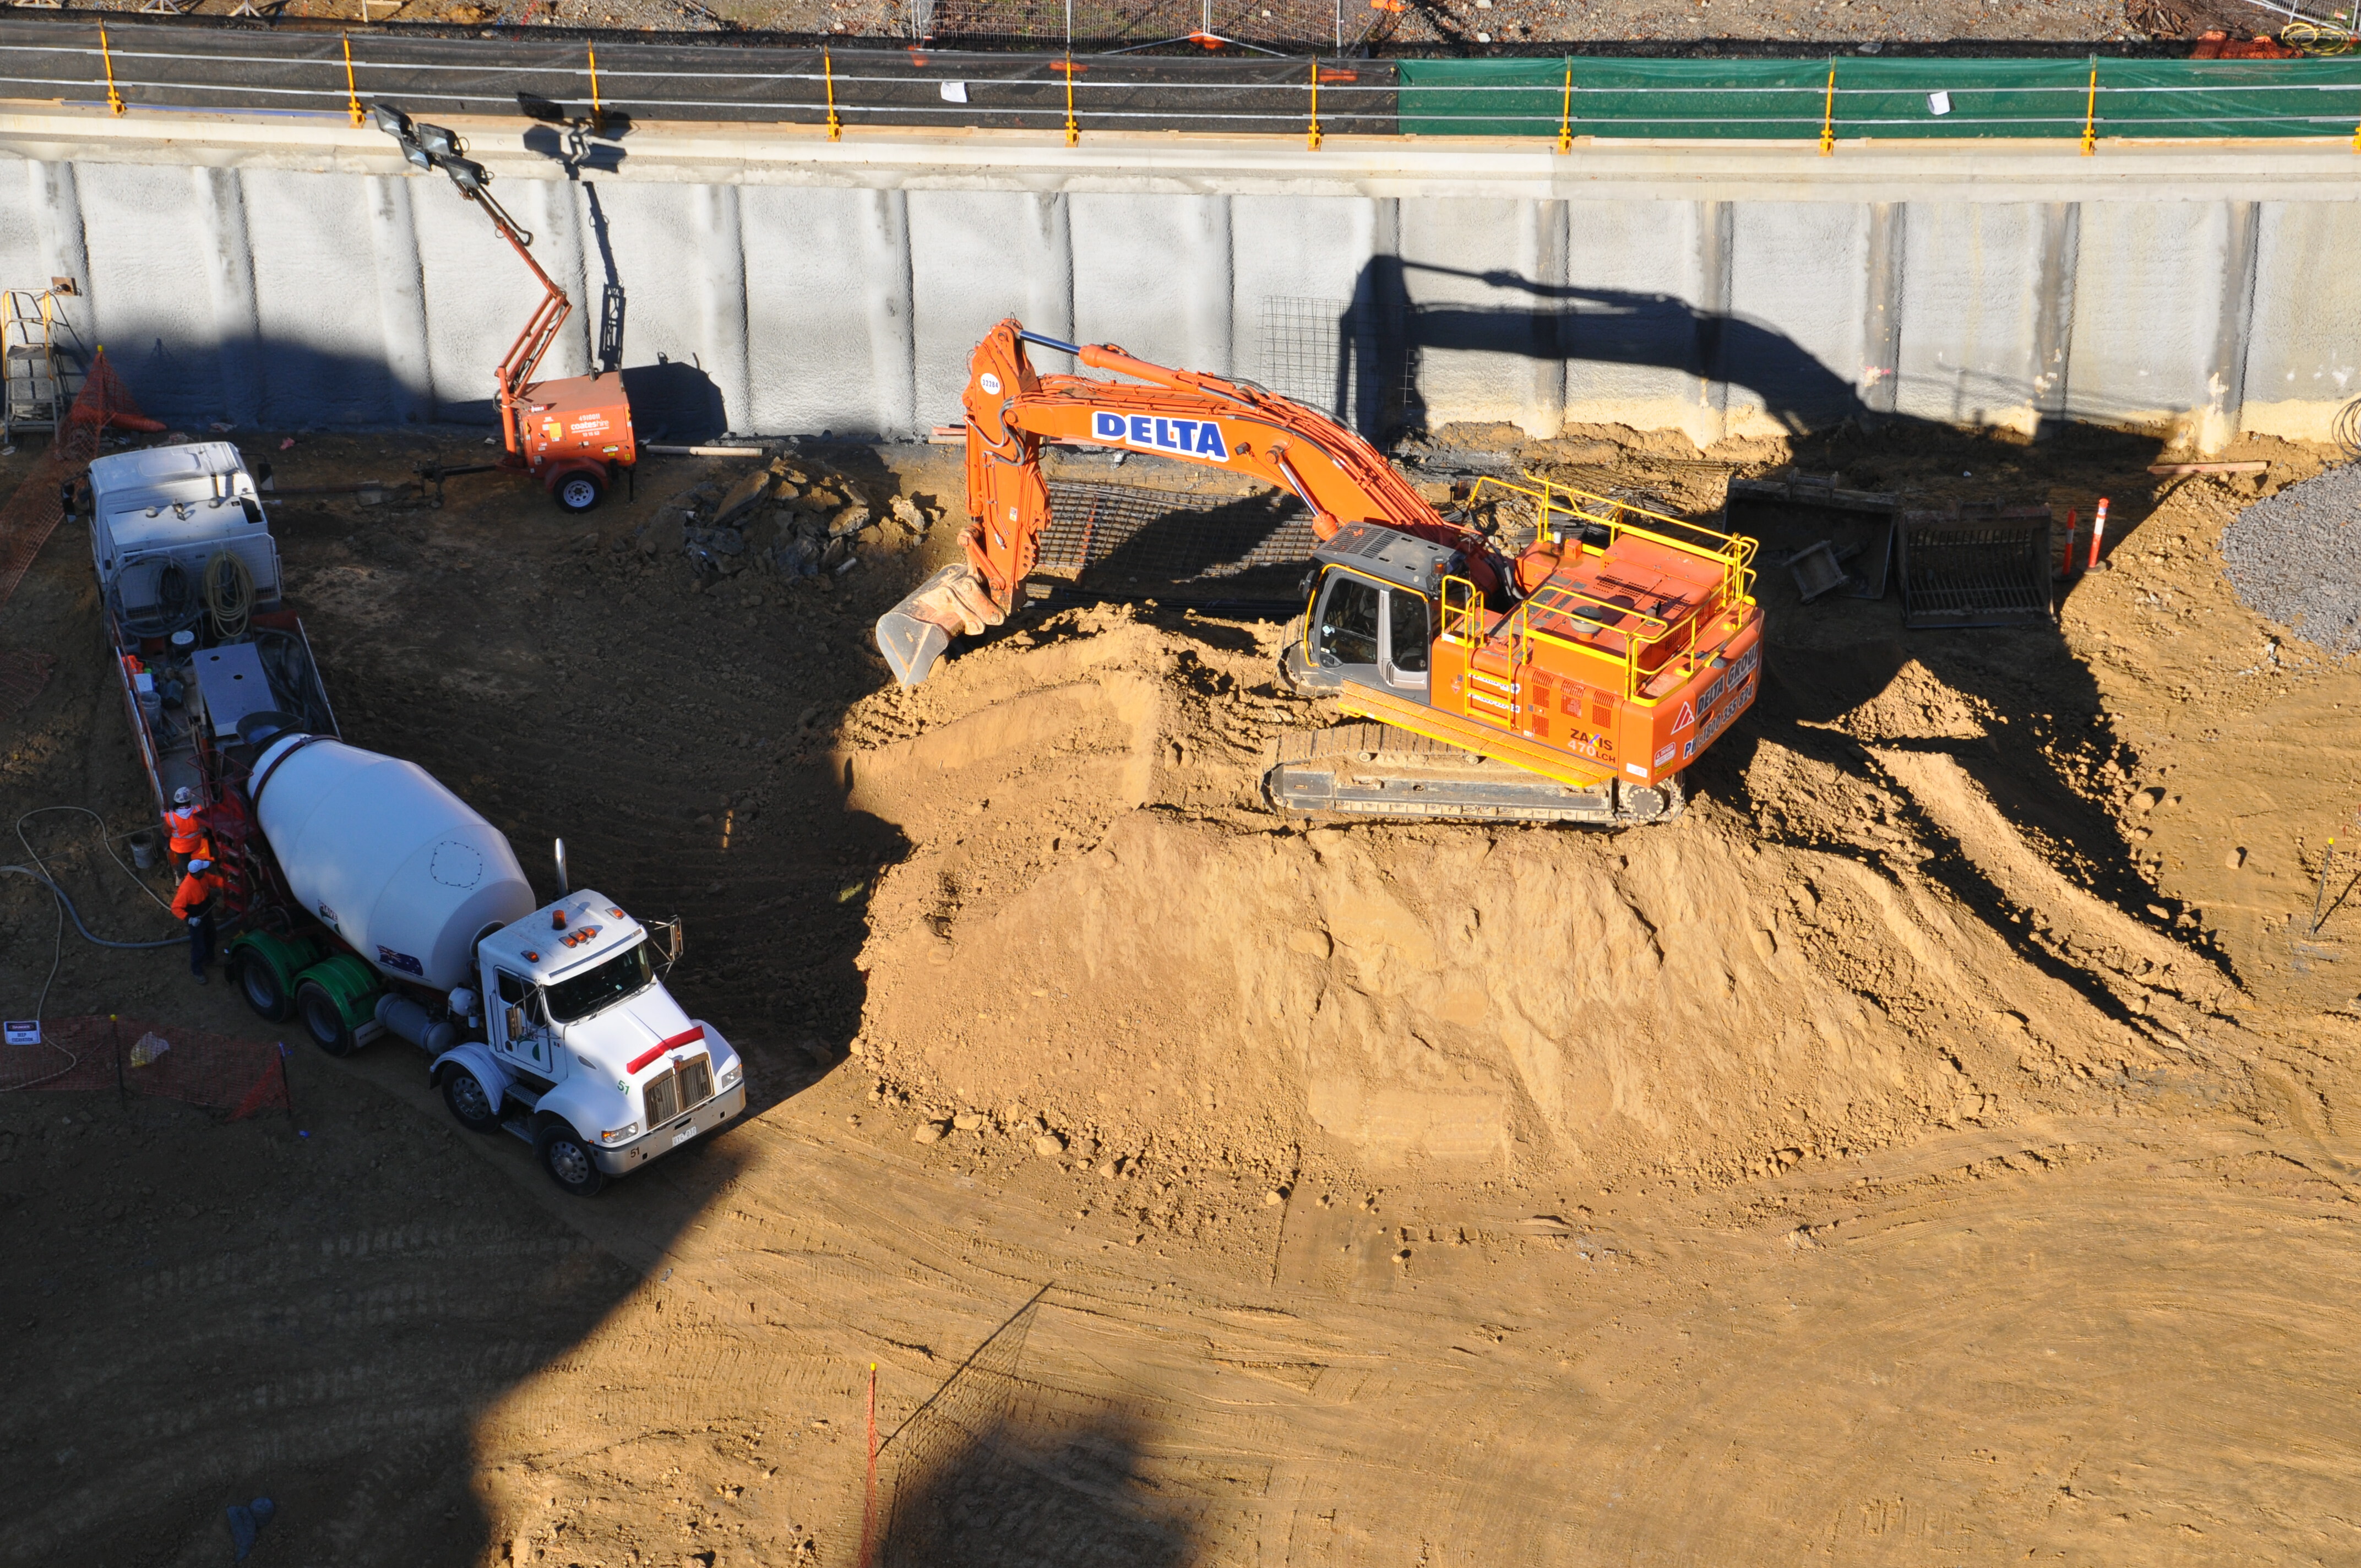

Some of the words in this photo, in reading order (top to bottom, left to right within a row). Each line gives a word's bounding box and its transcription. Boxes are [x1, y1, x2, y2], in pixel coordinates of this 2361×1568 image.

[982, 379, 998, 389] 32284
[1095, 412, 1228, 460] DELTA
[1697, 675, 1724, 717] DELTA
[1723, 698, 1737, 723] 355
[1739, 682, 1754, 707] 824
[1570, 727, 1613, 751] ZAXIS
[1568, 740, 1596, 756] 470
[1596, 750, 1616, 764] LCH
[617, 1080, 630, 1096] 51
[630, 1146, 640, 1158] 51
